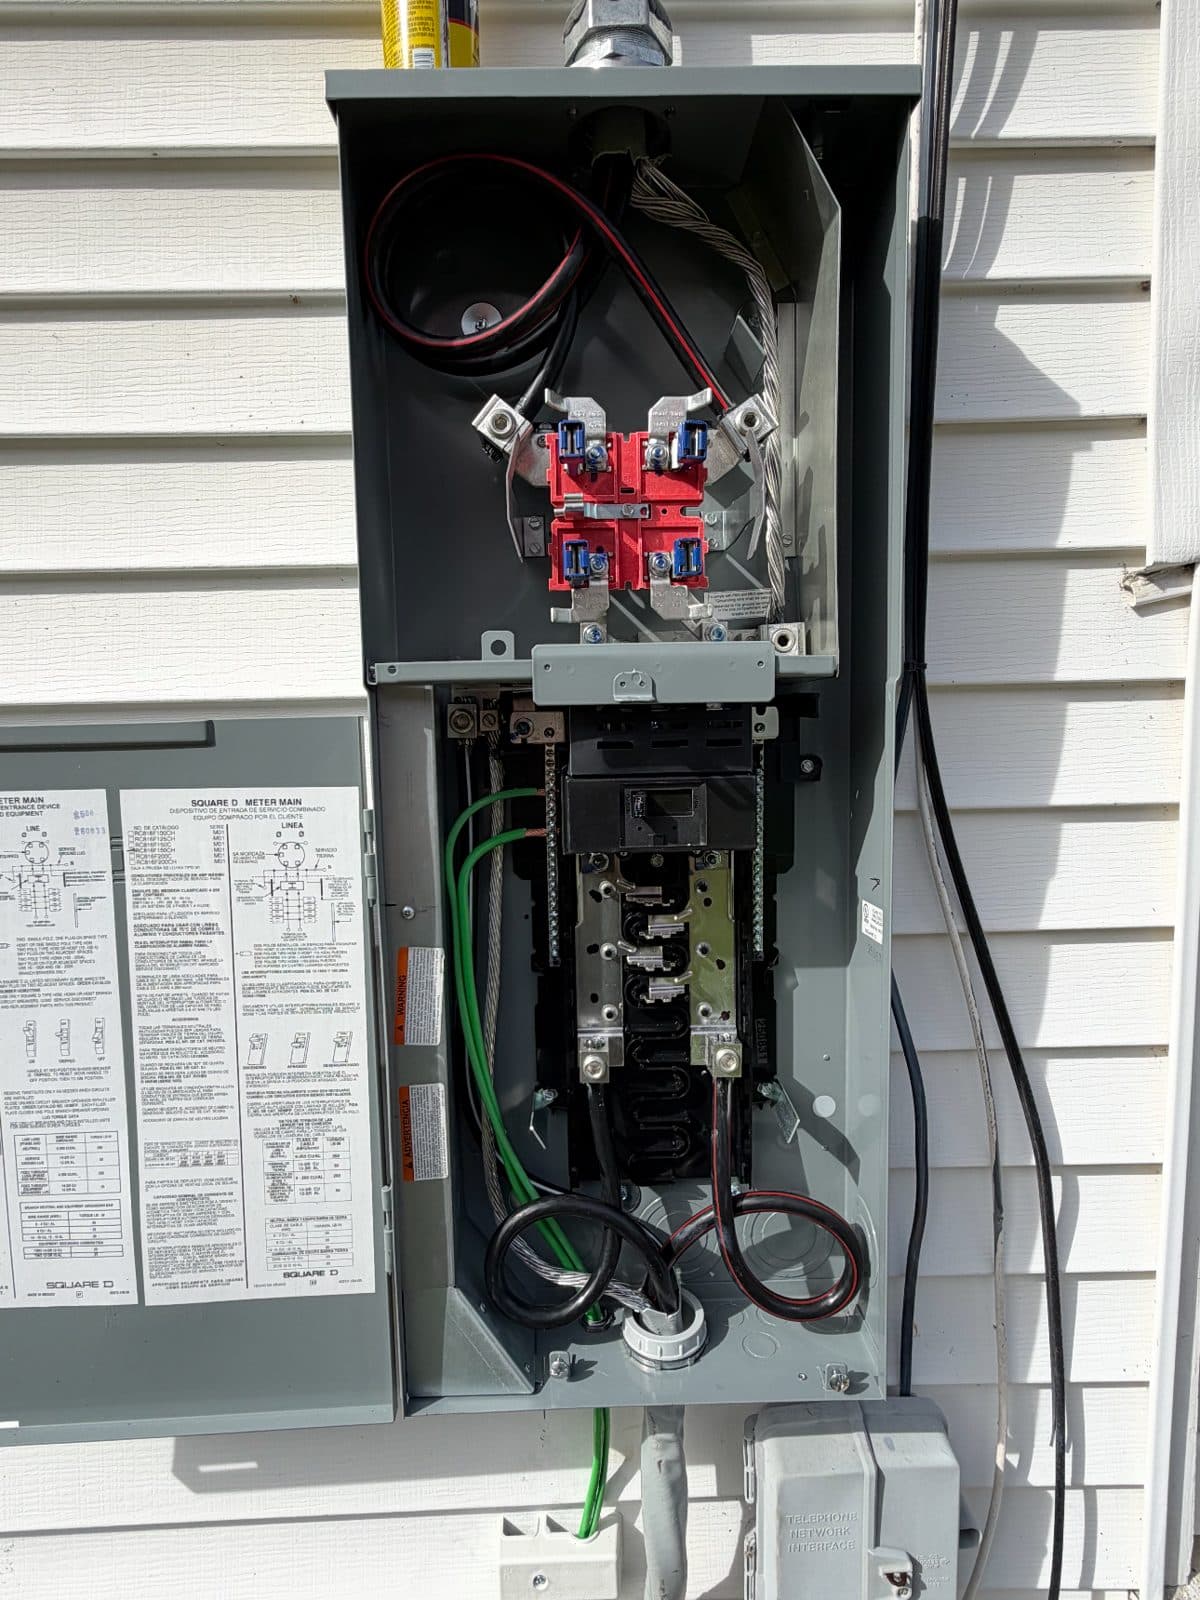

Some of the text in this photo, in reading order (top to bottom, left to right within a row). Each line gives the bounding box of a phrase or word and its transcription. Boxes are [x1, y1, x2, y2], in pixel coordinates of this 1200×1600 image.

[191, 799, 229, 807] SQUARE
[279, 798, 302, 806] MAIN
[397, 975, 406, 1015] WARNING
[282, 1270, 325, 1279] SQUARE
[46, 1280, 114, 1289] SQUARE D
[784, 1512, 857, 1524] TELEPHONE
[790, 1527, 849, 1538] NETWORK
[787, 1540, 855, 1552] INTERFACE
